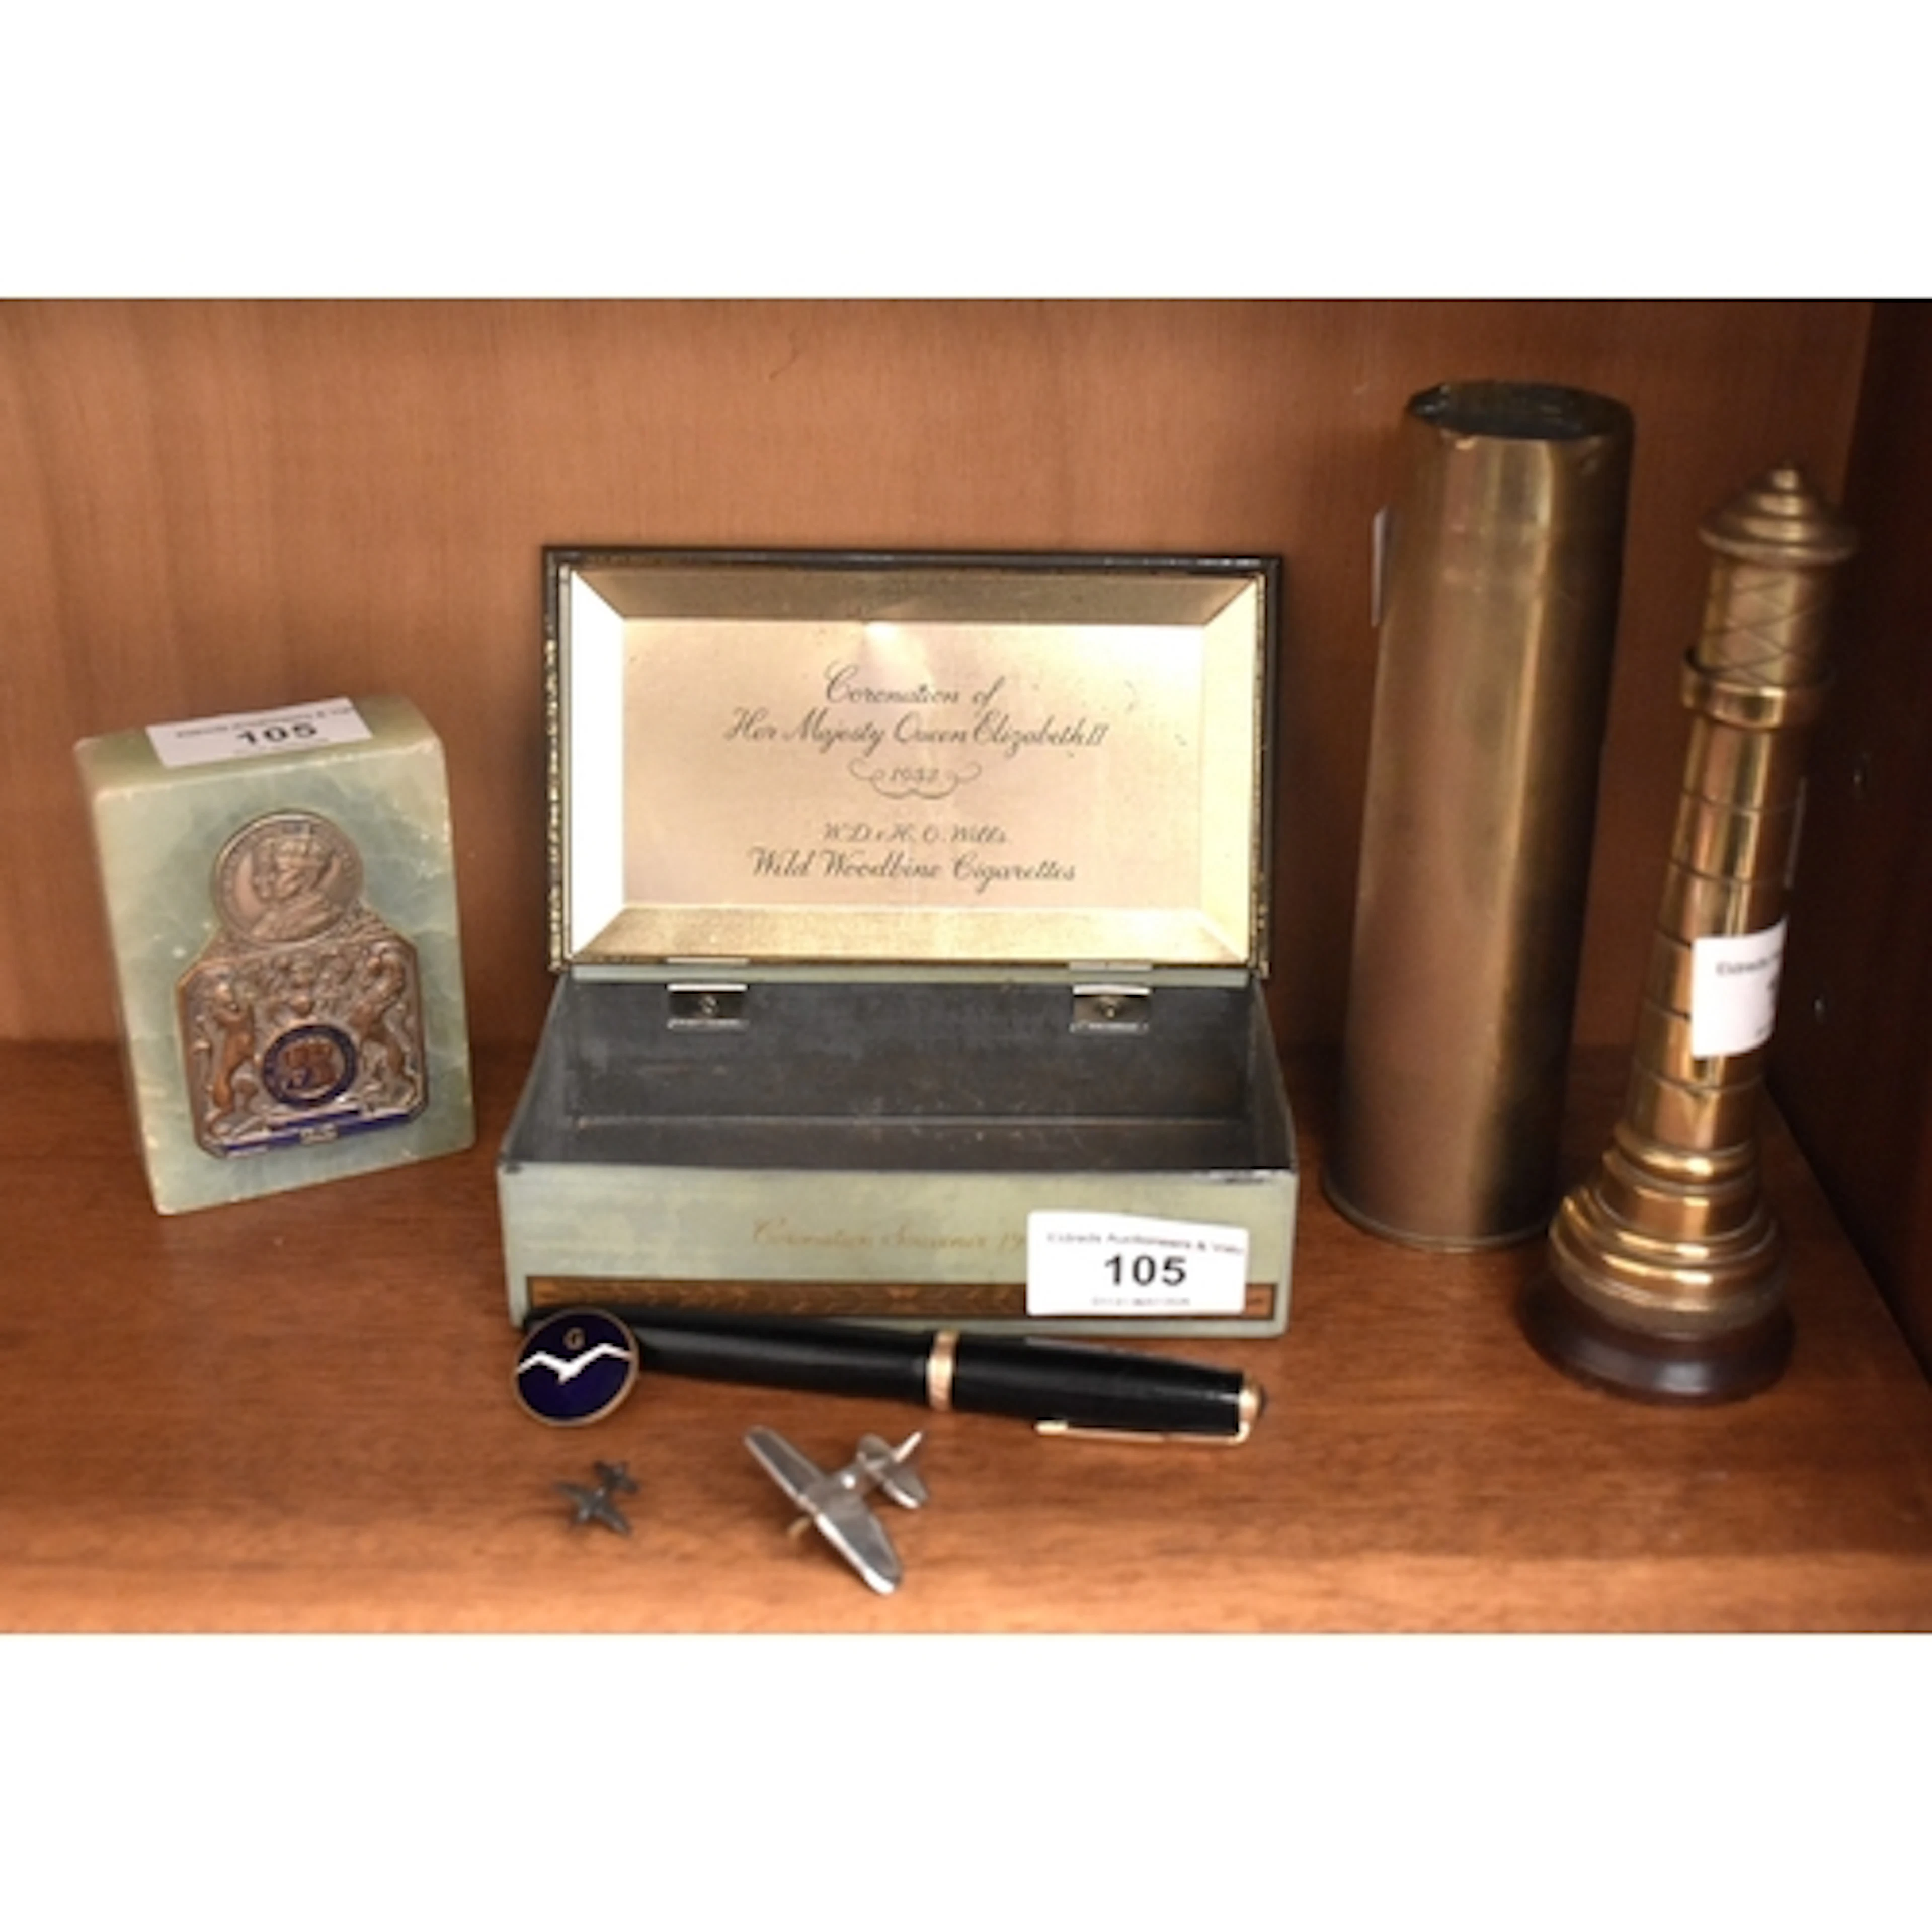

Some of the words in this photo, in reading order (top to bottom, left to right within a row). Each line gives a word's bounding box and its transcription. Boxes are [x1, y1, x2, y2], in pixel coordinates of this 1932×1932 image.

[825, 660, 960, 705] Coronation
[971, 676, 1006, 708] of
[236, 722, 318, 746] 105
[723, 708, 777, 742] Her
[782, 708, 887, 756] Majesty
[892, 710, 967, 744] Queen
[973, 710, 1085, 756] Elizabeth
[746, 846, 816, 878] Wild
[819, 850, 942, 878] Woodbine
[952, 849, 1077, 894] Cigarettes
[1105, 1254, 1188, 1287] 105
